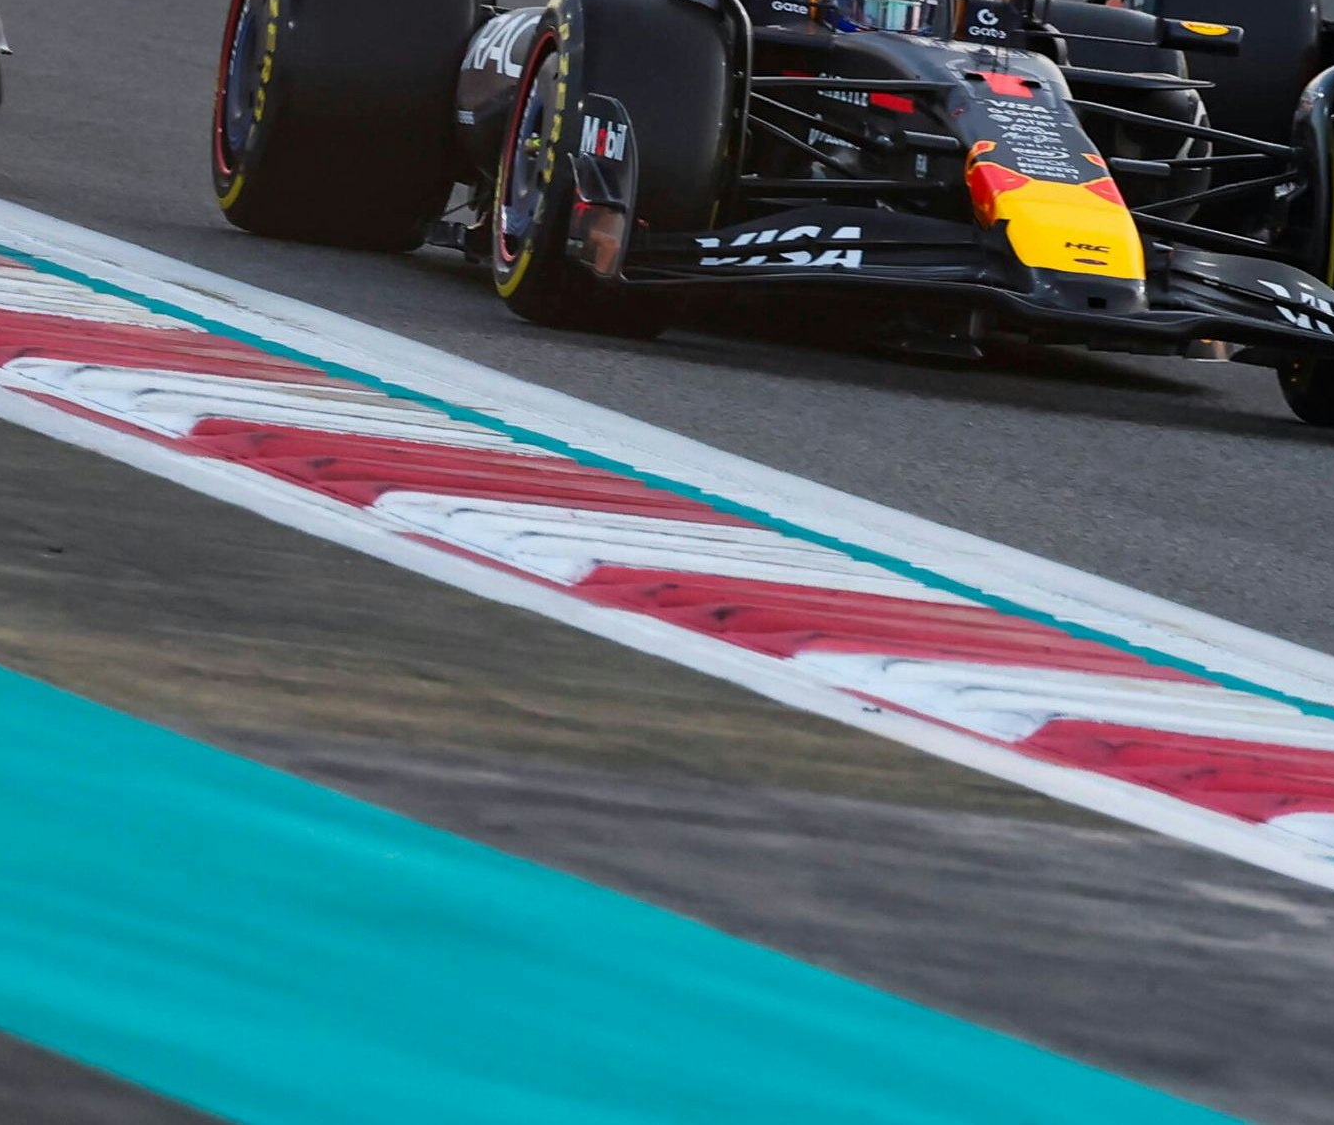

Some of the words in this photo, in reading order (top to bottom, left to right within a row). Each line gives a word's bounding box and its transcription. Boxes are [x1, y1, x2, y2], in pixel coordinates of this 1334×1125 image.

[771, 0, 809, 15] Gate
[984, 98, 1051, 114] VISA
[579, 114, 628, 163] Mobil
